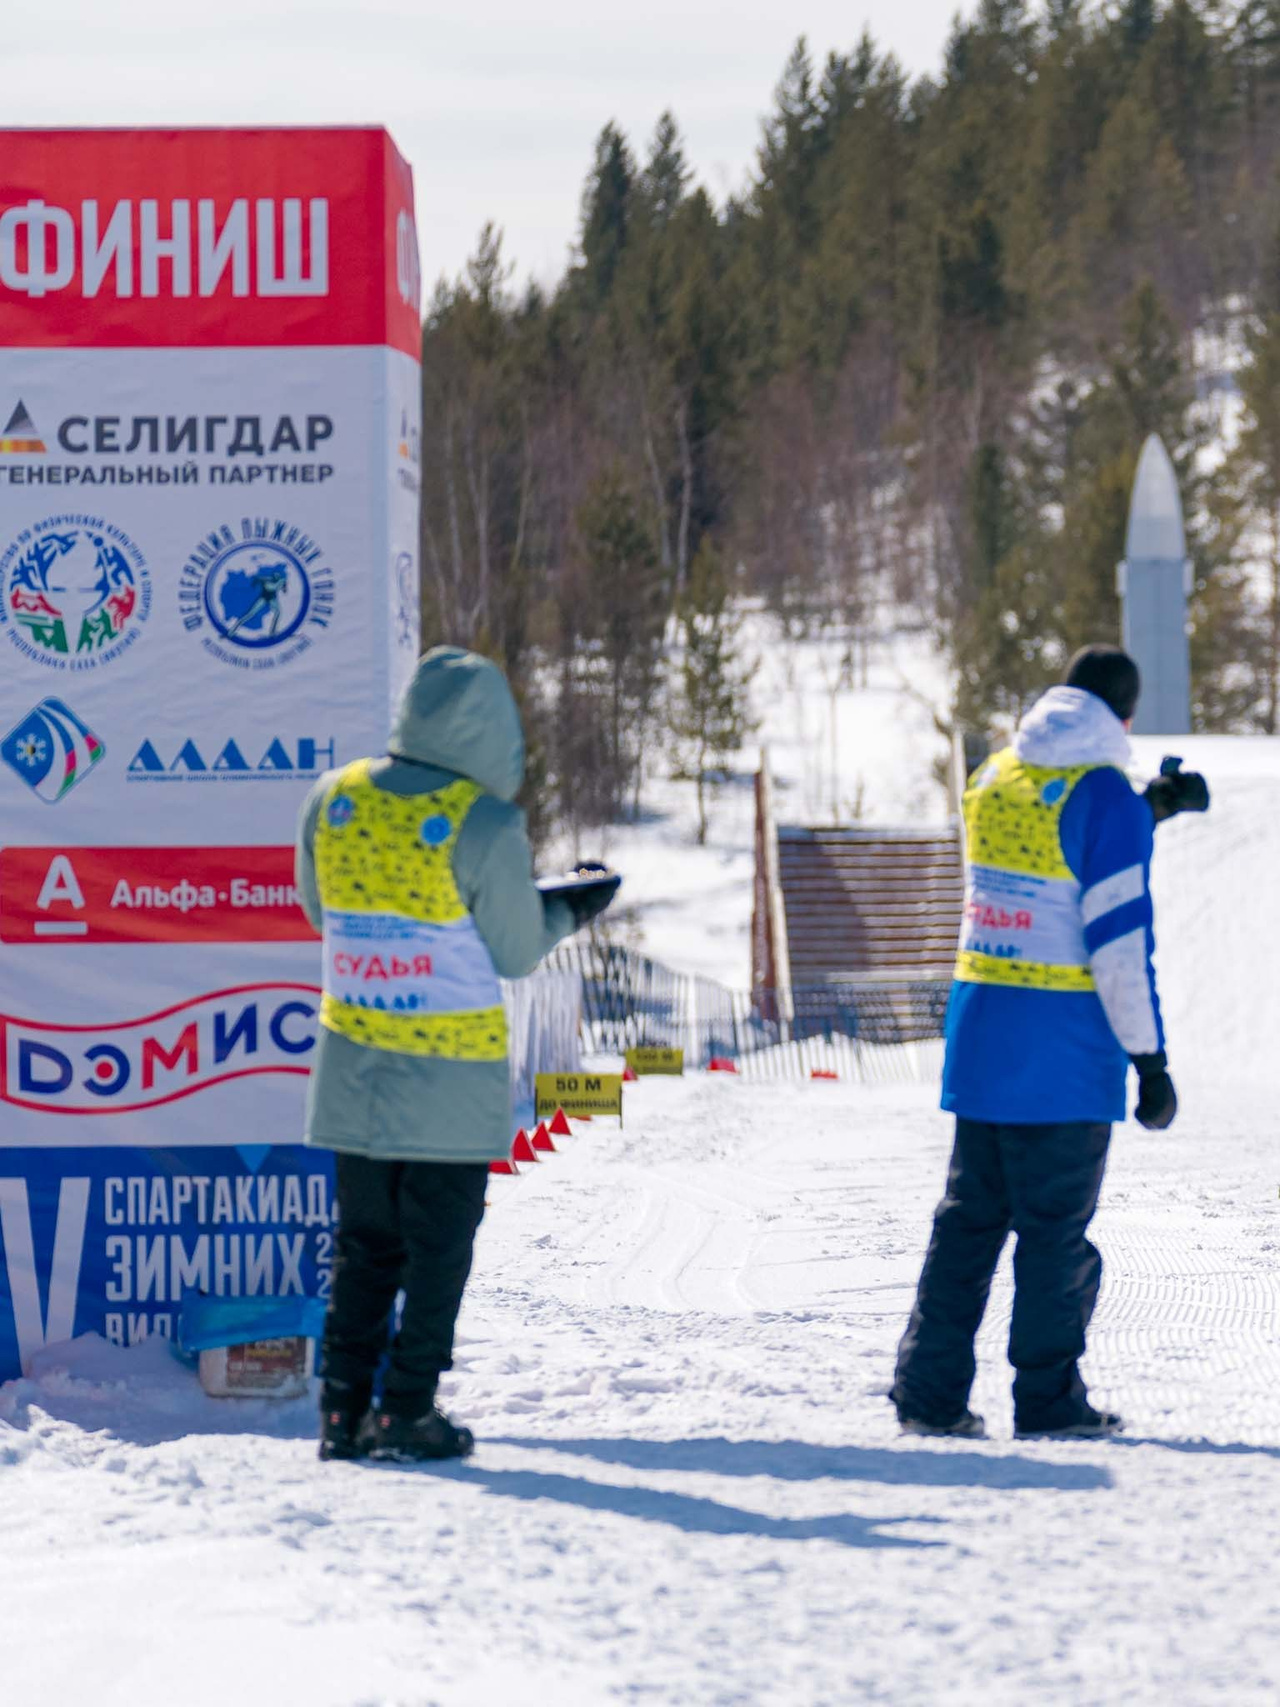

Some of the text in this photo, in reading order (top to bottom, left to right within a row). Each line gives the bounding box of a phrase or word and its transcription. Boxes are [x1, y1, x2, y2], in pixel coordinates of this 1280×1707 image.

[0, 198, 330, 298] ФИНИШ
[57, 415, 334, 457] СЕЛИГДАР
[209, 464, 334, 484] ПАРТНЕР
[333, 952, 434, 984] СУДЬЯ
[556, 1076, 579, 1092] 50
[104, 1174, 339, 1228] СПАРТАКИАД
[0, 1176, 91, 1378] V
[105, 1233, 306, 1302] ЗИМНИХ
